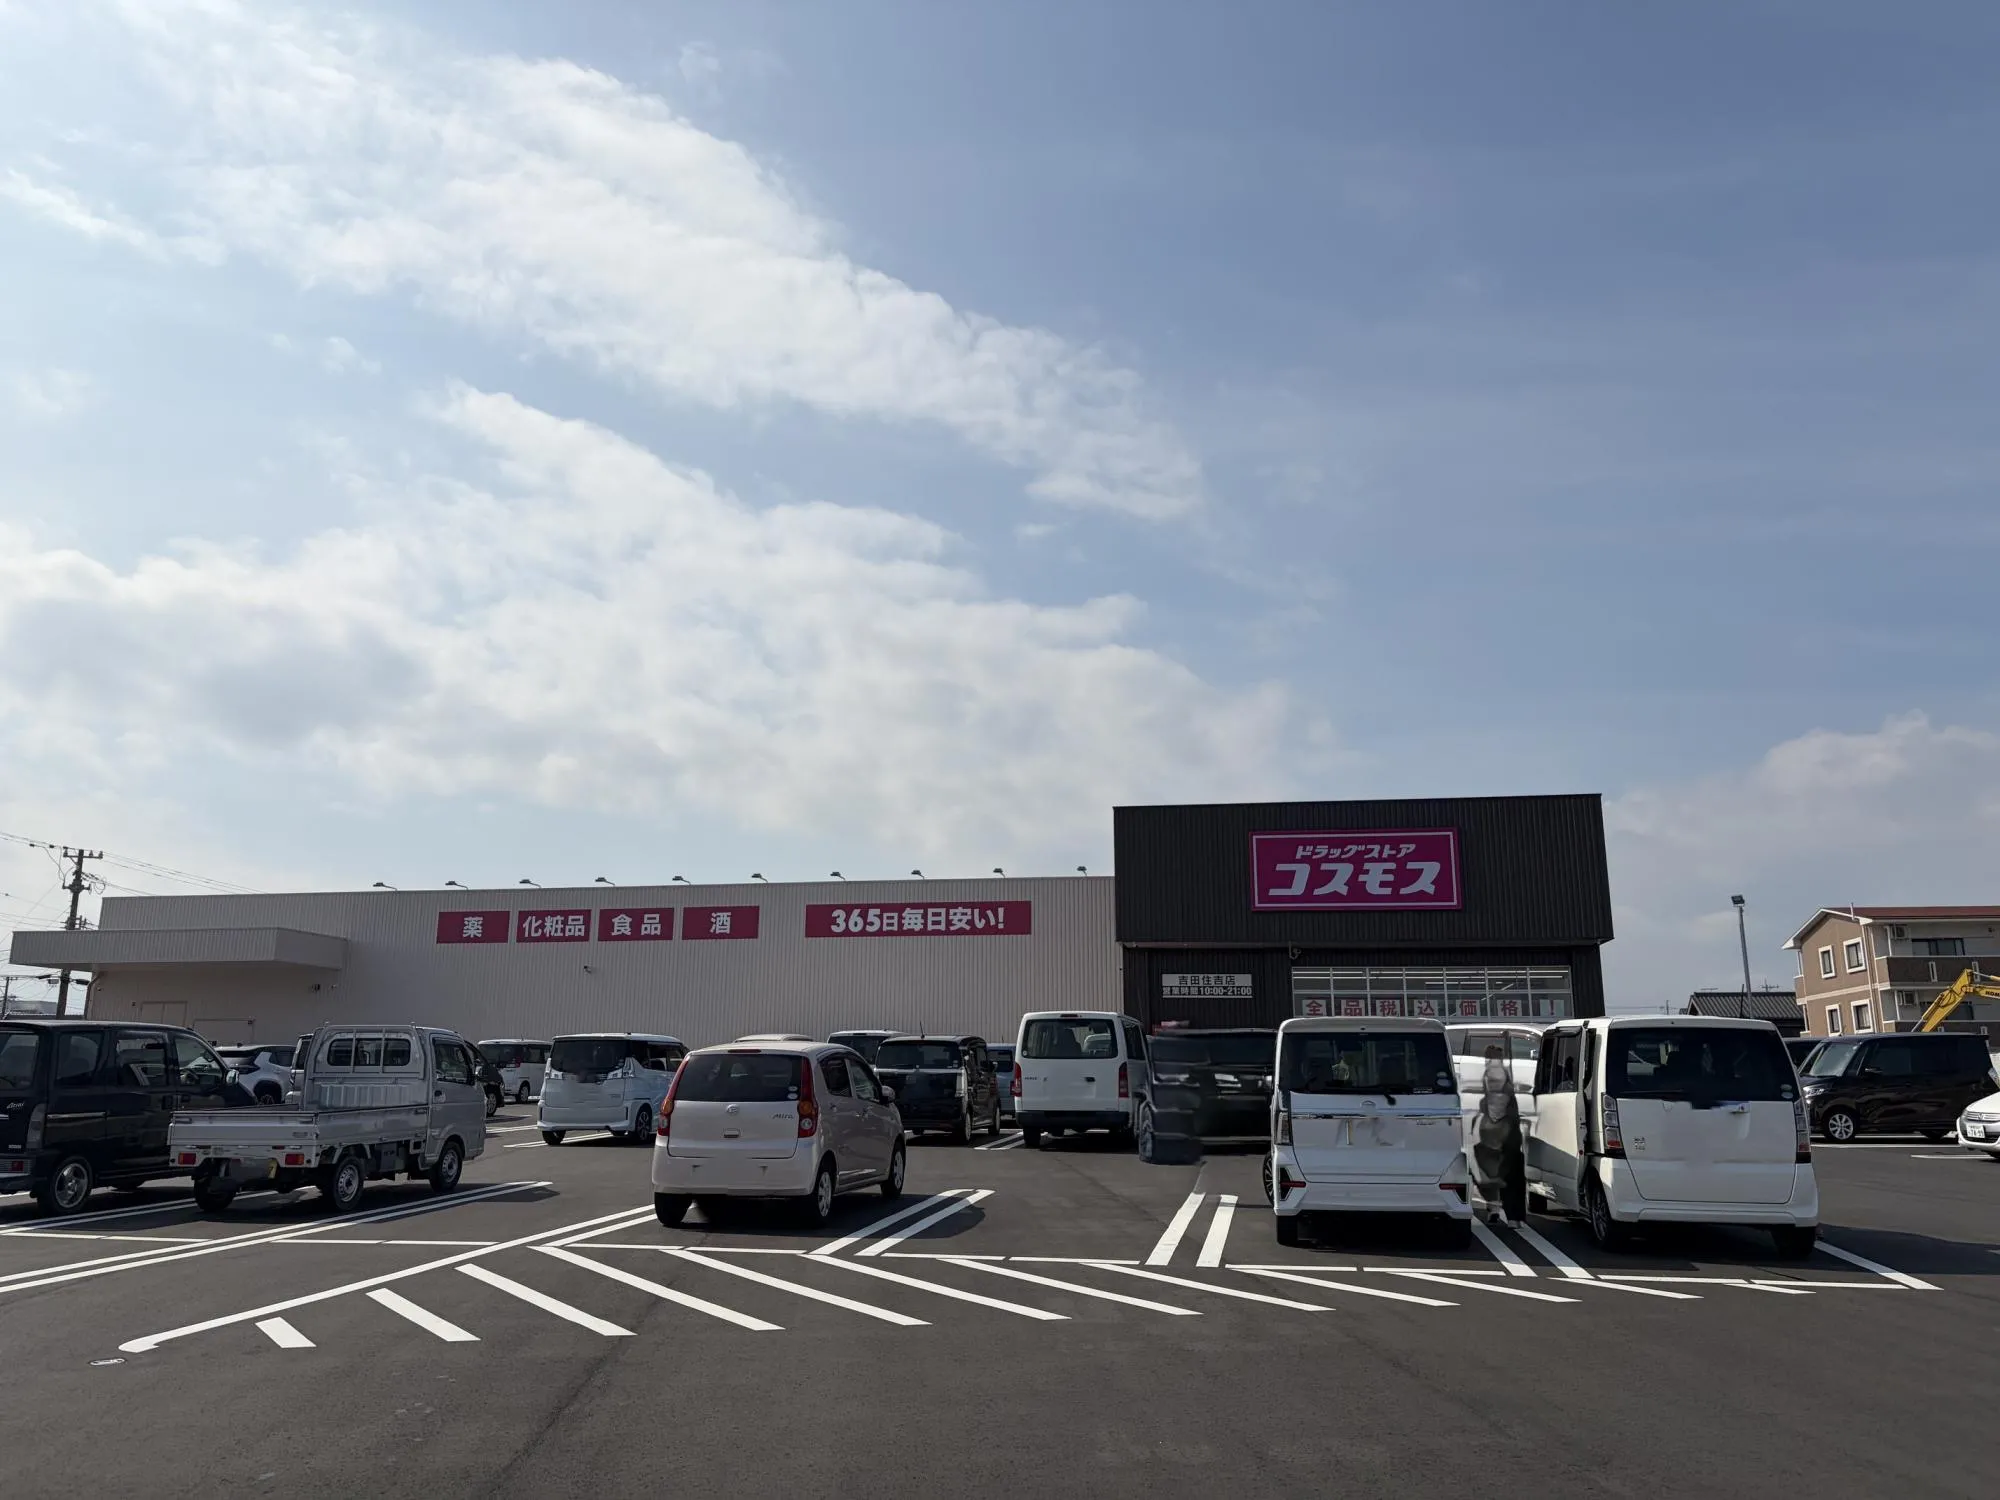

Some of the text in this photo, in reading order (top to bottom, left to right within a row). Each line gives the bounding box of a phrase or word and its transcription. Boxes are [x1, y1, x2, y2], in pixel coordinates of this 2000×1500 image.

[1295, 844, 1416, 859] ドラッグストア
[1268, 861, 1441, 896] コスモス
[462, 916, 483, 938] 薬
[522, 915, 585, 938] 化粧品
[611, 913, 661, 936] 食品
[710, 912, 732, 934] 酒
